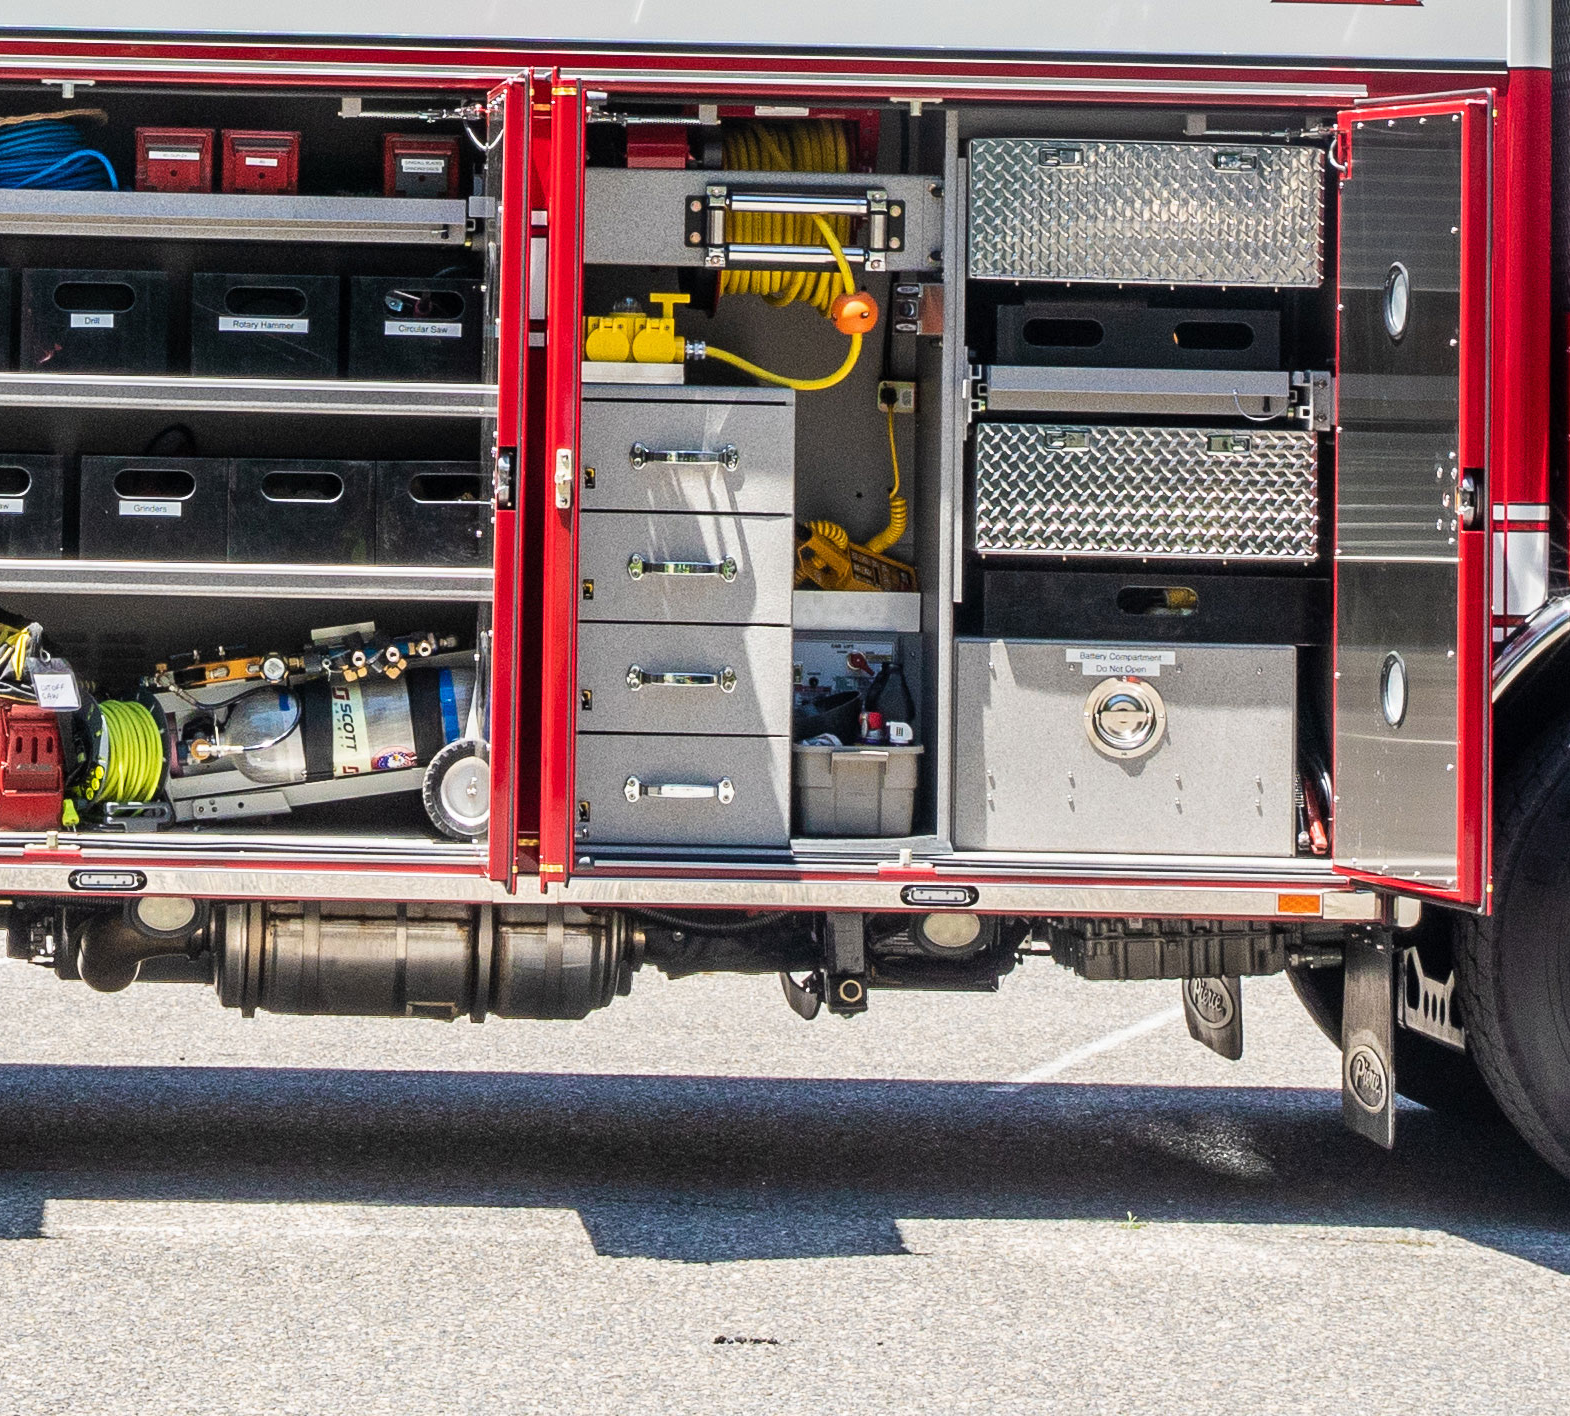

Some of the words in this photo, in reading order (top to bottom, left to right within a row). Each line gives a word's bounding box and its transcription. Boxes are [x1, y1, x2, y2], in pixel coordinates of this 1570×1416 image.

[84, 316, 101, 325] Drill
[233, 320, 258, 330] Rotary
[260, 321, 295, 330] Hammer
[398, 324, 429, 334] Circular
[430, 325, 448, 334] Saw
[133, 503, 168, 514] Grinders
[1080, 651, 1107, 661] Battery
[1109, 652, 1162, 662] Compartment
[1096, 665, 1108, 673] Do
[1109, 665, 1123, 673] Not
[1125, 665, 1147, 674] Open
[340, 703, 358, 752] SCOTT
[1355, 1054, 1383, 1096] Pierce
